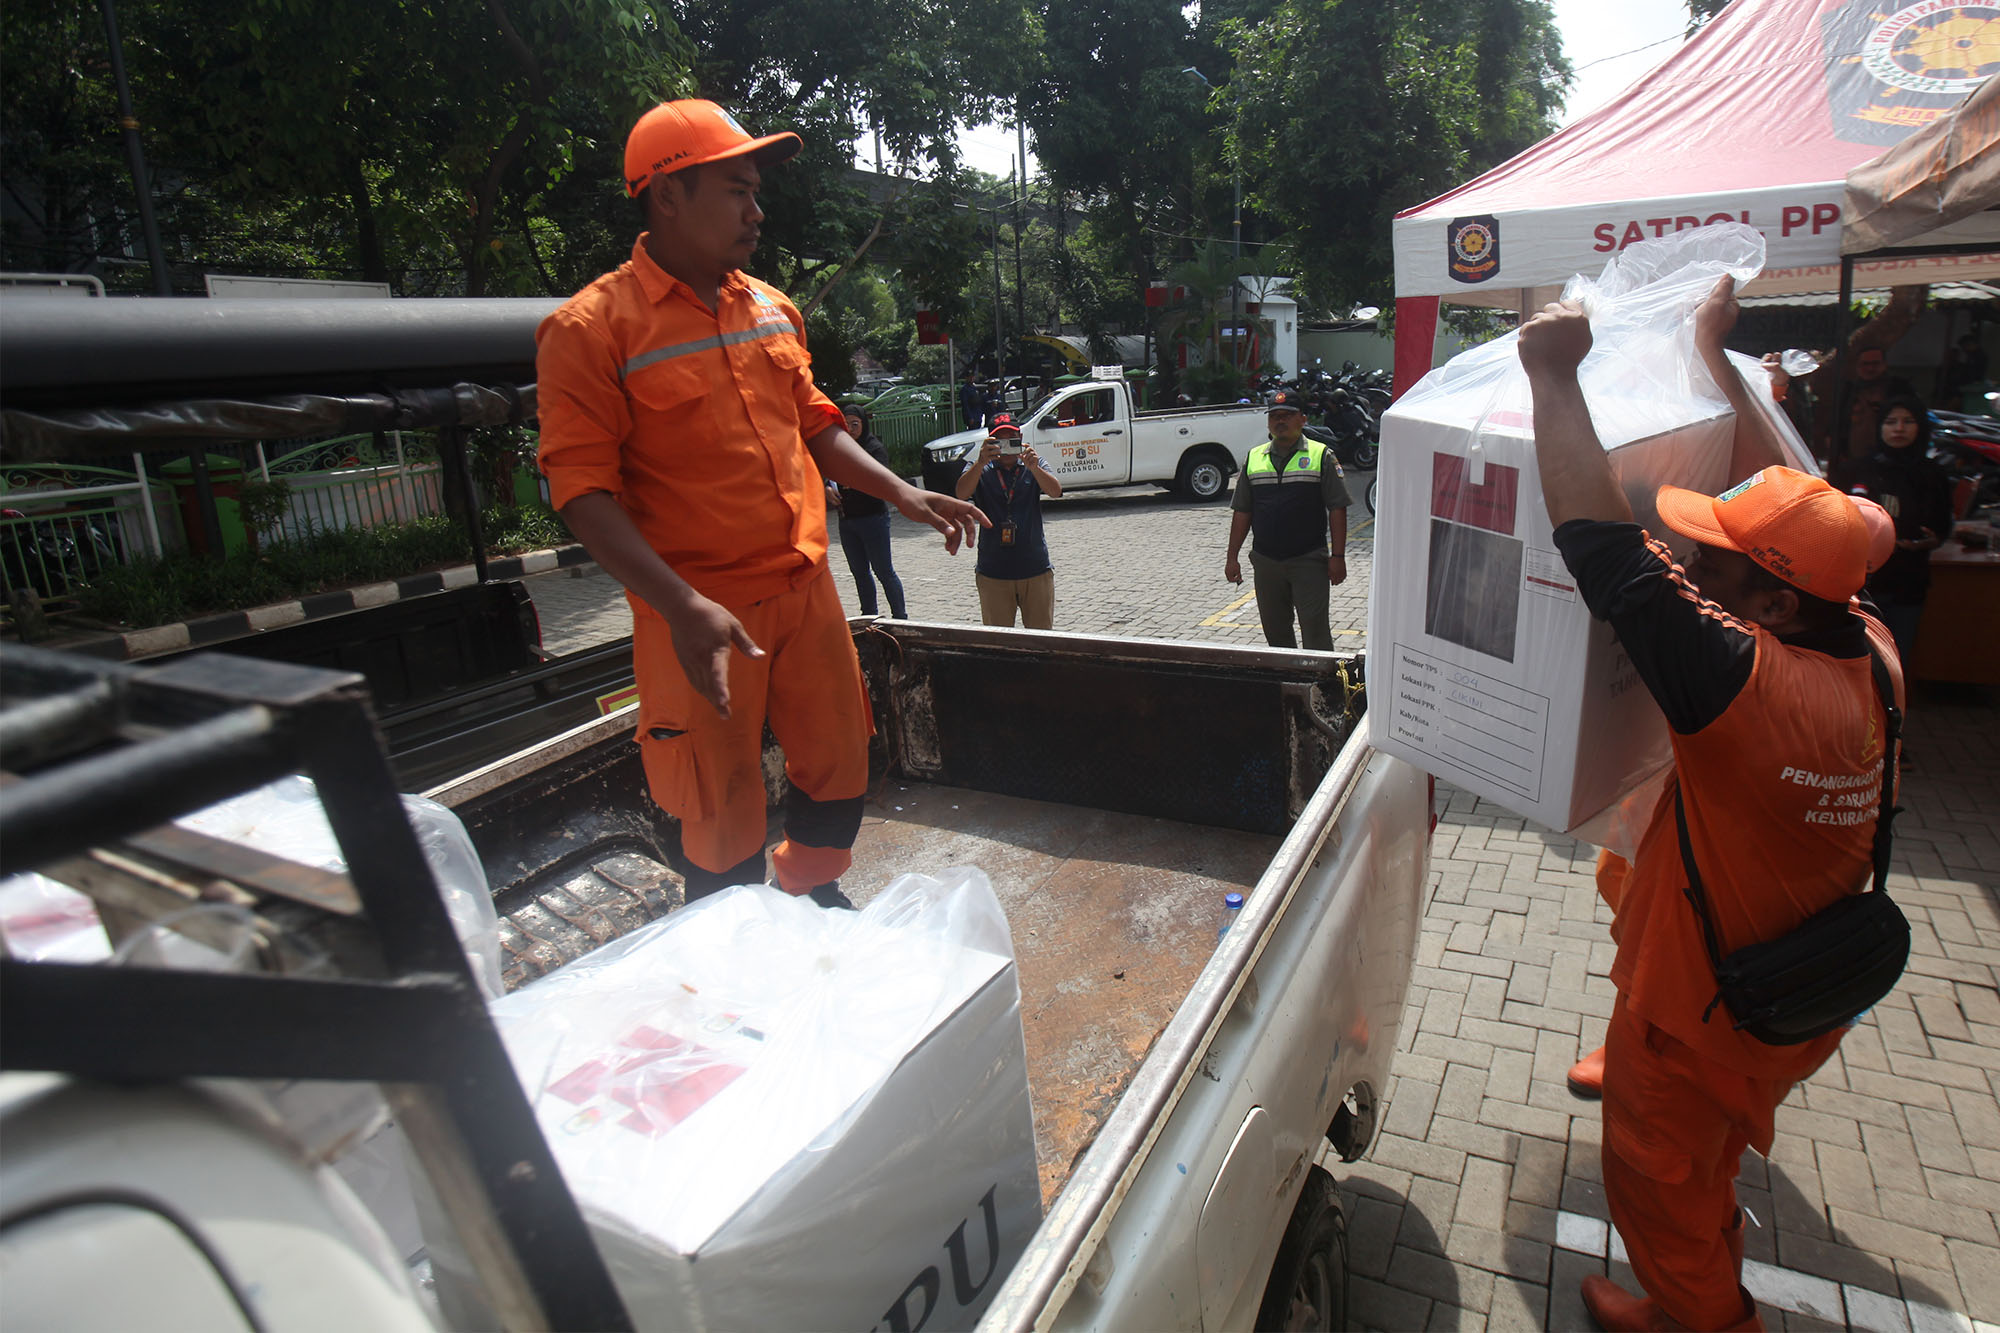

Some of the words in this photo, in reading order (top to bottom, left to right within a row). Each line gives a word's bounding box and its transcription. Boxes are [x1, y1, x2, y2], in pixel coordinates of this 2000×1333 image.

[1872, 11, 1916, 43] POLISI
[1781, 203, 1841, 237] PP
[1061, 447, 1075, 457] PP
[1087, 445, 1100, 455] SU
[1063, 458, 1098, 467] KELURAHAN
[1403, 655, 1424, 669] Nomor
[1425, 663, 1438, 674] TPS
[1401, 673, 1422, 687] Lokasi
[1423, 681, 1436, 692] PPS
[1454, 672, 1479, 688] 004
[1400, 691, 1422, 705] Lokasi
[1422, 699, 1436, 711] PPK
[1399, 709, 1430, 727] Kab/Kota
[1398, 726, 1424, 743] Provinsi
[1817, 794, 1830, 807] &
[1832, 785, 1878, 808] SARANA
[870, 1182, 1000, 1333] PU
